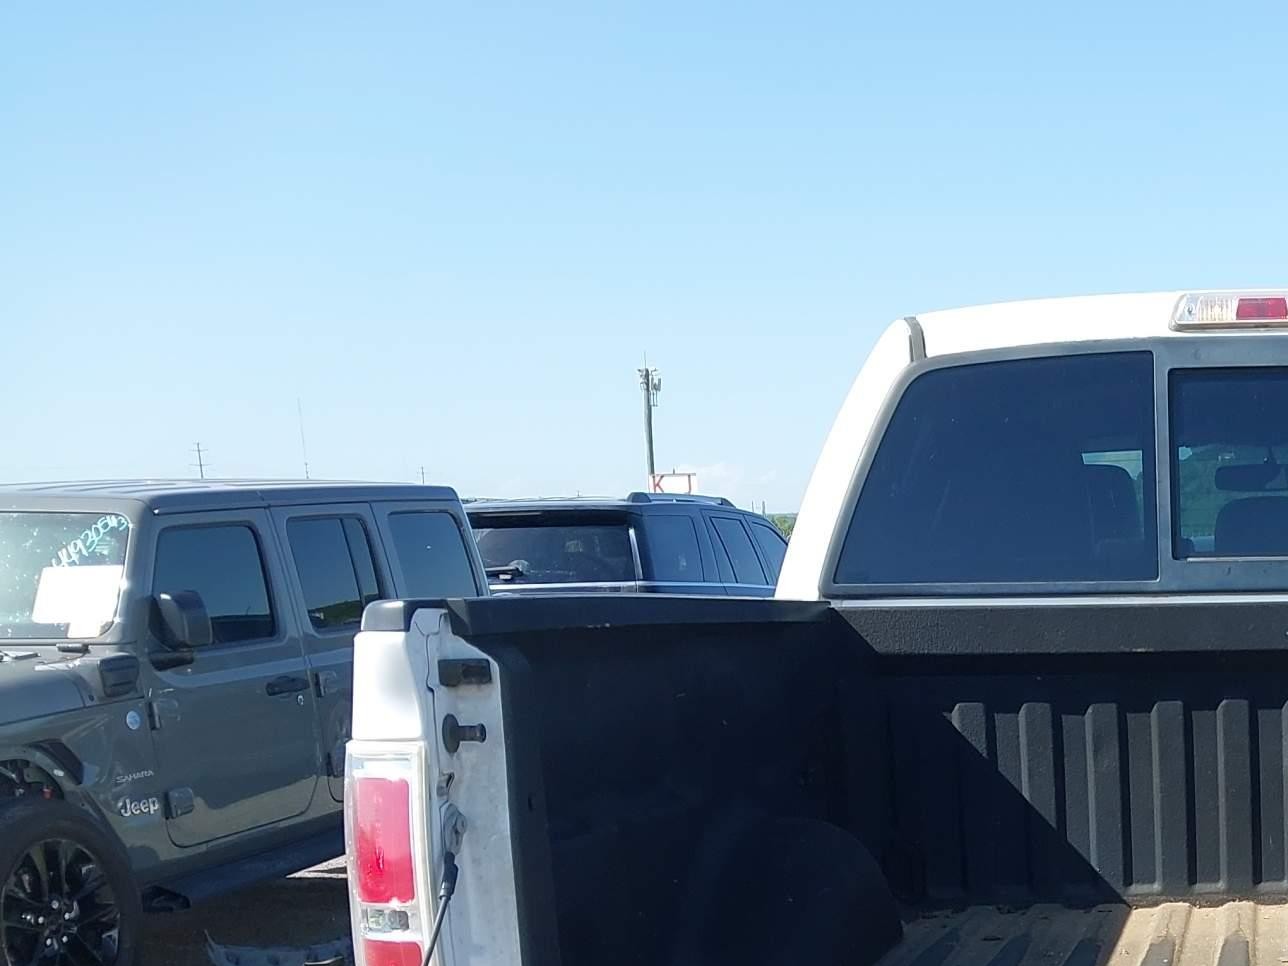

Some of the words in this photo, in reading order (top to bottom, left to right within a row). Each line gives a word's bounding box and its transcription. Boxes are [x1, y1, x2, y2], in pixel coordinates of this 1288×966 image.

[652, 475, 665, 493] K
[116, 769, 155, 783] SAHARA
[119, 797, 159, 817] Jeep
